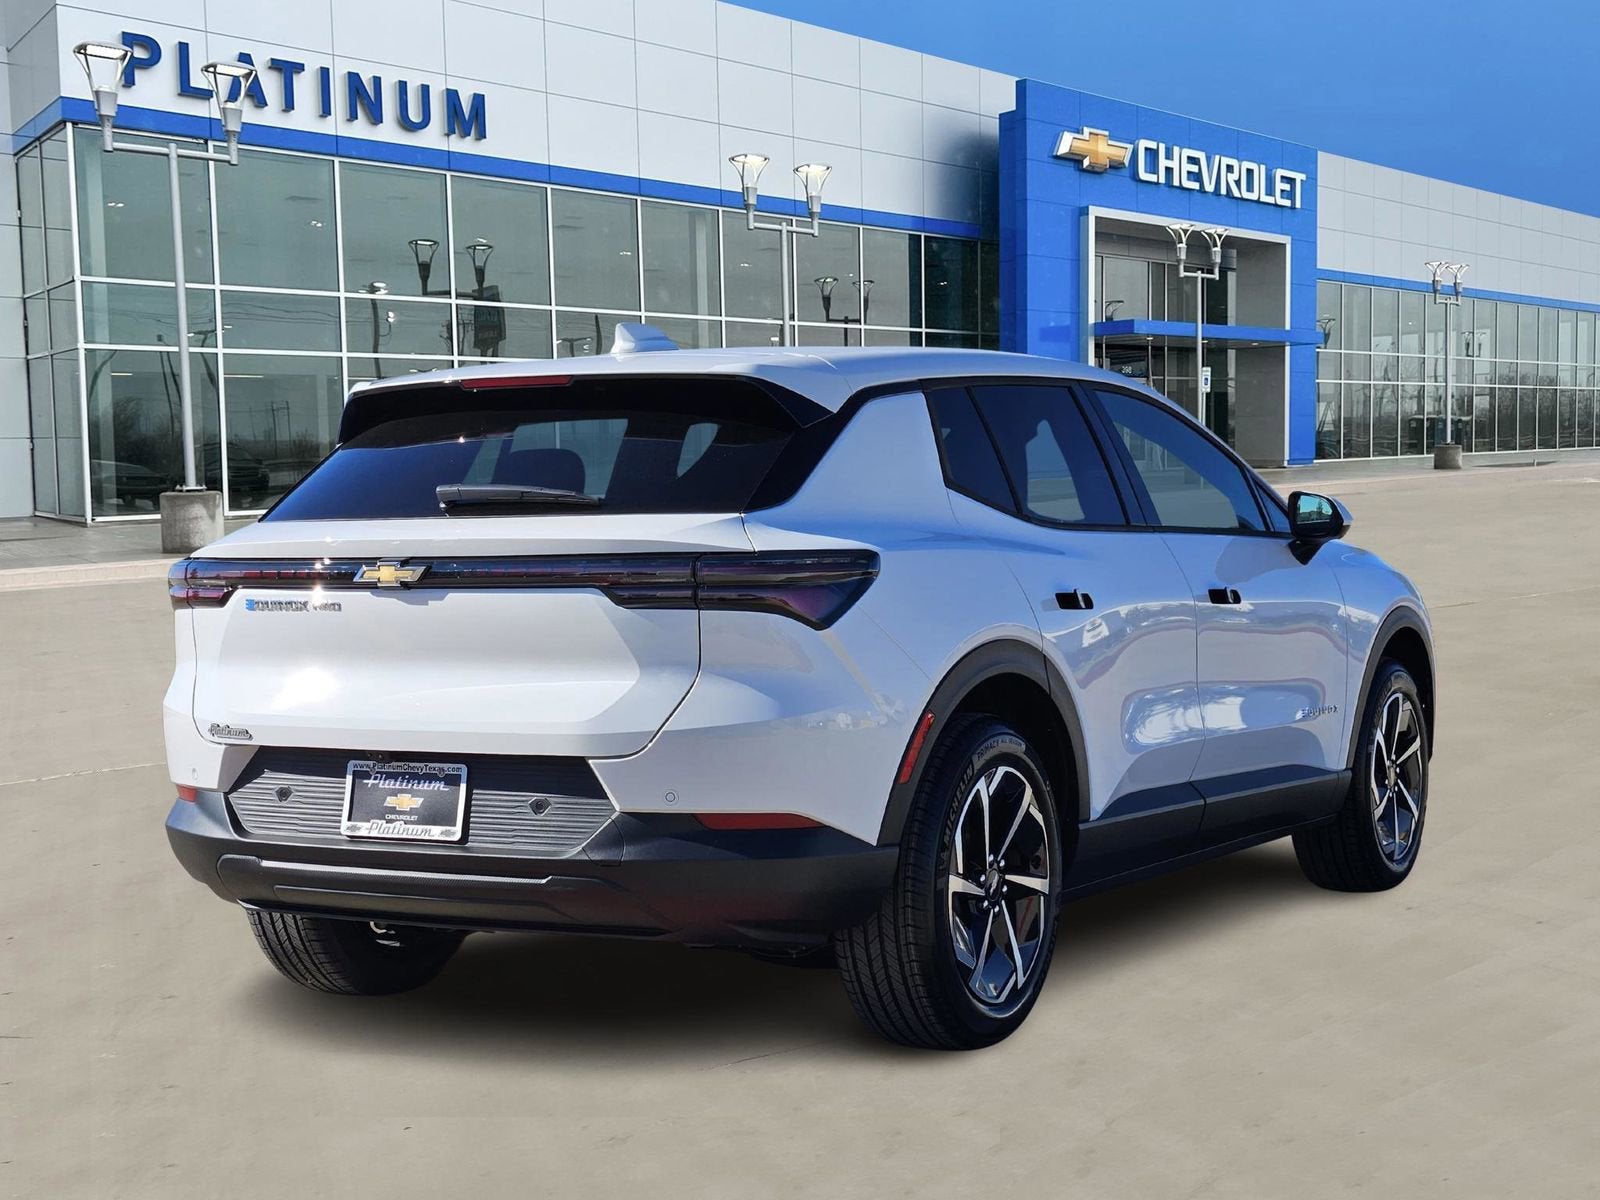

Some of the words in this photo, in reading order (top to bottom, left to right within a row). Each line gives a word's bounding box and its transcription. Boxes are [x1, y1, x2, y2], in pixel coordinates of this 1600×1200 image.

[121, 31, 487, 140] PLATINUM
[1136, 138, 1307, 209] CHEVROLET
[363, 773, 450, 791] Platinum
[366, 820, 436, 838] Platinum
